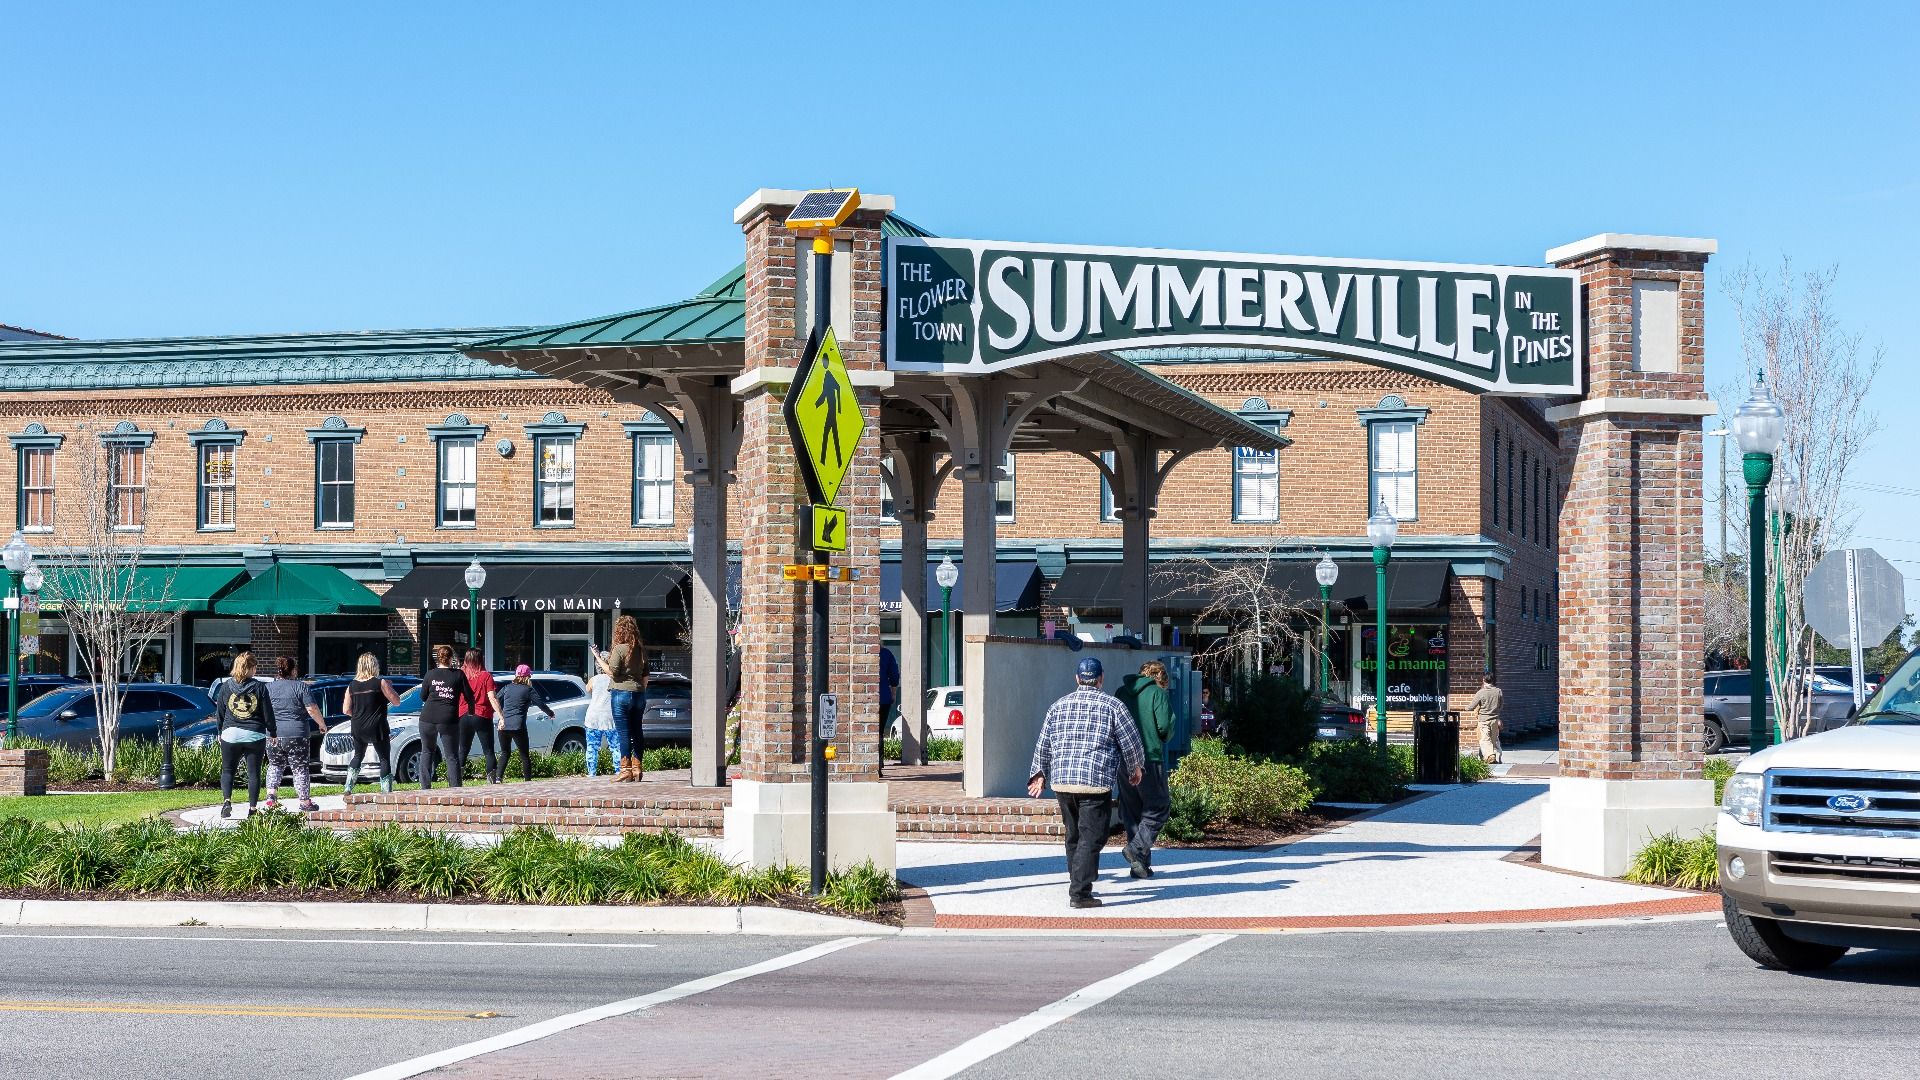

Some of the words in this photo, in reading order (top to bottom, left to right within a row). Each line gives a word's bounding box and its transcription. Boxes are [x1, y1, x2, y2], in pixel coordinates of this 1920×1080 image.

[900, 262, 932, 282] THE
[900, 279, 968, 319] FLOWER
[1514, 291, 1532, 309] IN
[987, 256, 1495, 369] SUMMERVILLE
[1529, 312, 1560, 331] THE
[912, 322, 963, 341] TOWN
[1512, 335, 1572, 363] PINES
[442, 598, 527, 610] PROPERITY
[534, 599, 555, 610] ON
[563, 598, 602, 610] MAIN
[1353, 660, 1395, 671] cupa
[1400, 660, 1446, 669] manna
[1387, 683, 1411, 693] cafe
[1834, 796, 1860, 808] Ford
